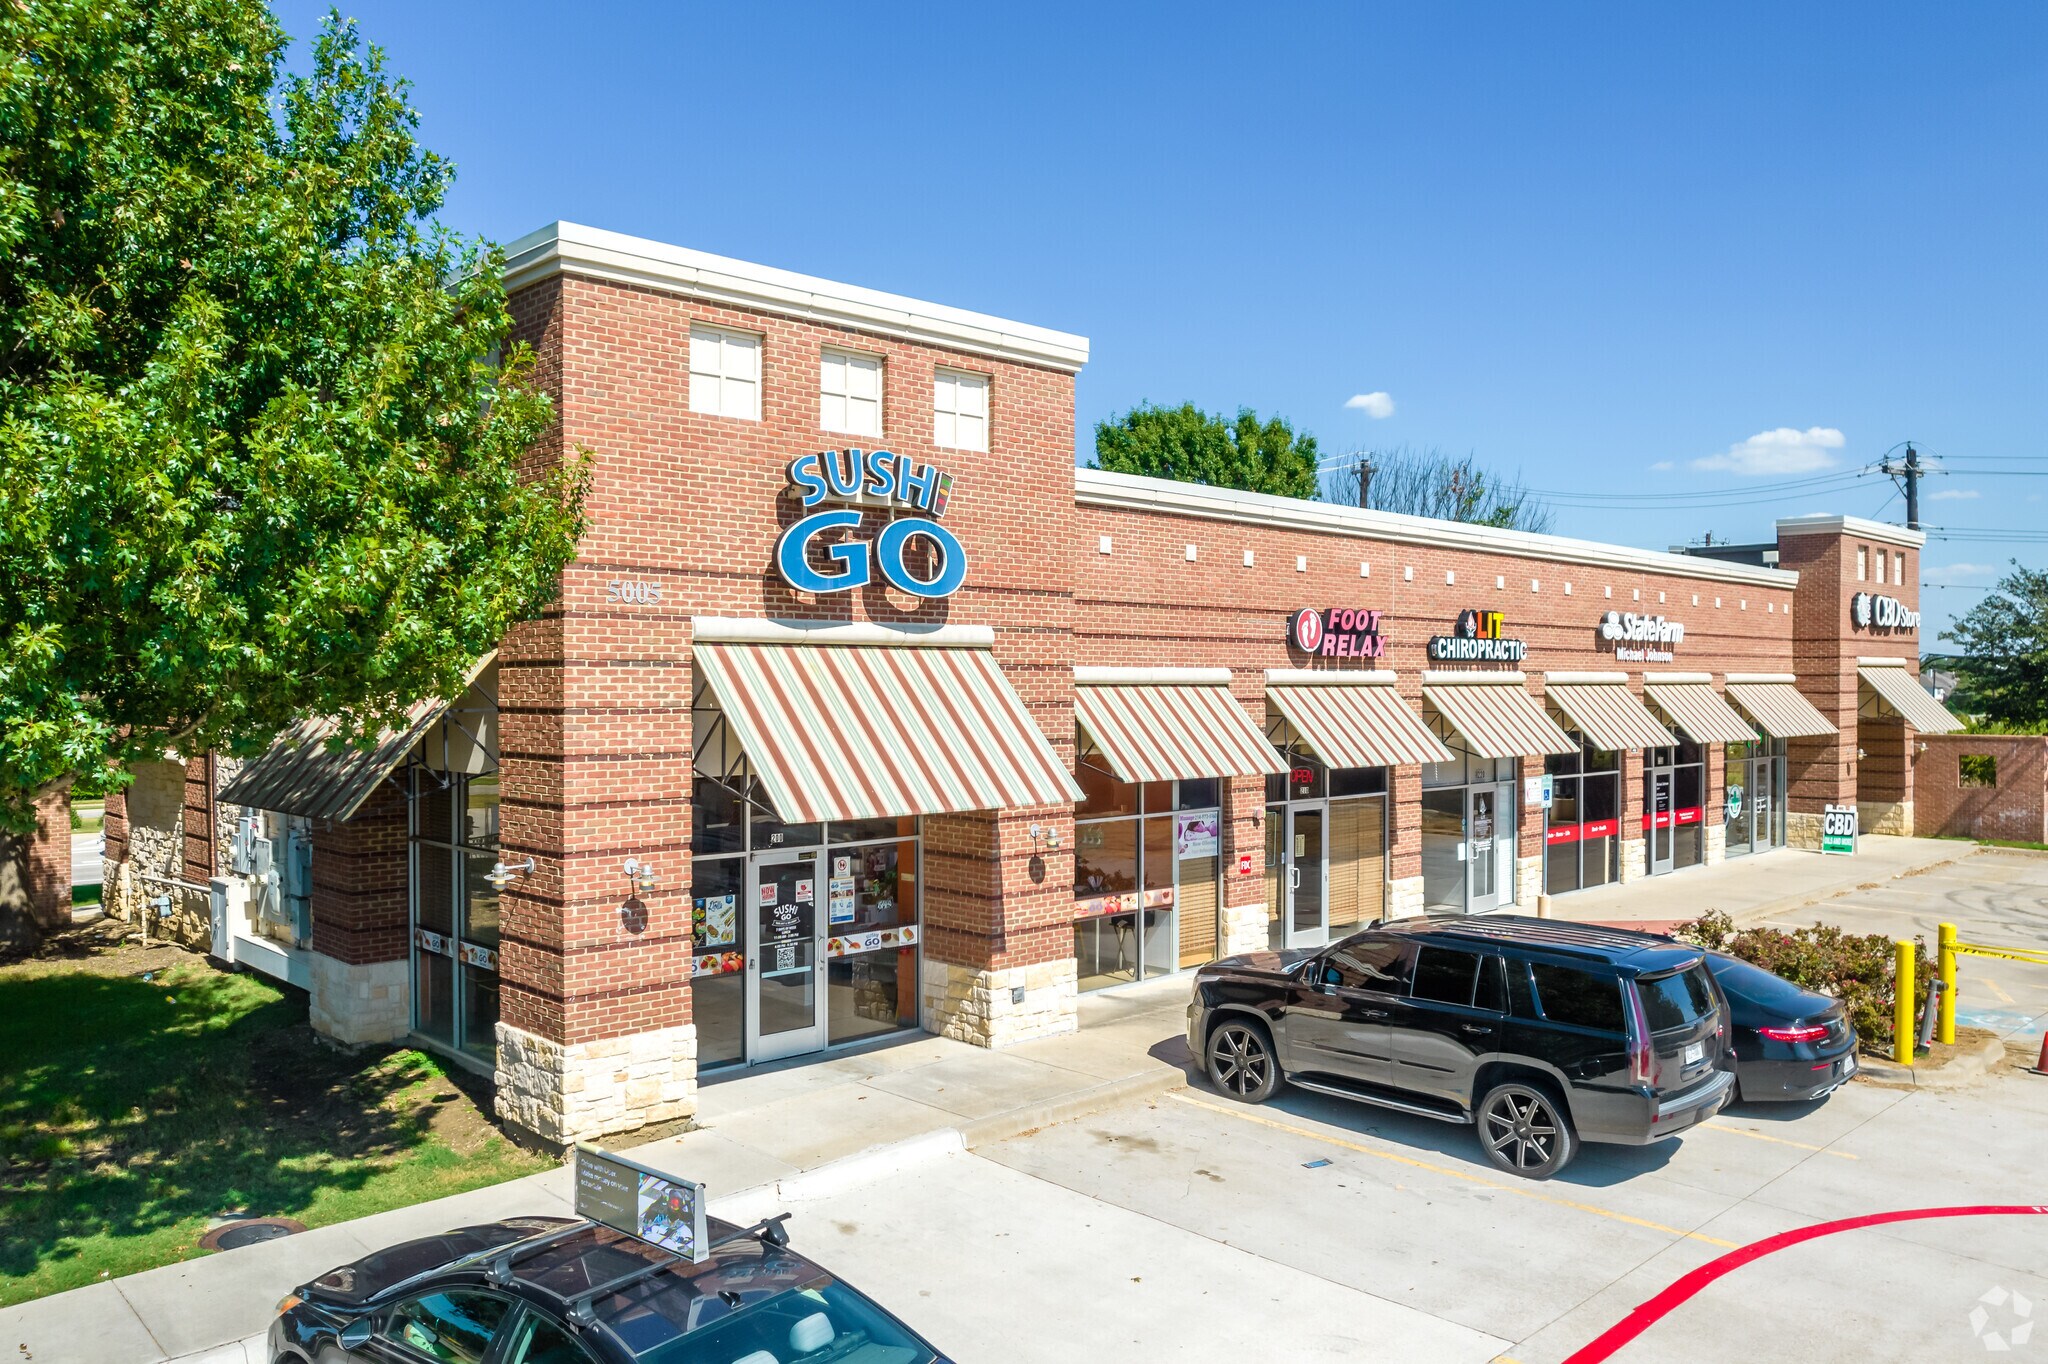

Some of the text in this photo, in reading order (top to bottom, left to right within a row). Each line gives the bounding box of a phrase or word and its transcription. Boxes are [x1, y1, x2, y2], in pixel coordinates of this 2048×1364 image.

[775, 510, 969, 598] GO
[607, 578, 663, 604] 5005
[1327, 608, 1385, 633] FOOT
[1875, 595, 1921, 628] CBD Store
[1476, 611, 1506, 639] LIT
[1321, 633, 1390, 658] RELAX
[1437, 638, 1529, 661] CHIROPRACTIC
[1290, 768, 1313, 783] OPEN
[1825, 812, 1855, 836] CBD
[1241, 861, 1251, 870] FDC
[761, 886, 775, 896] NOW
[864, 938, 880, 947] GO
